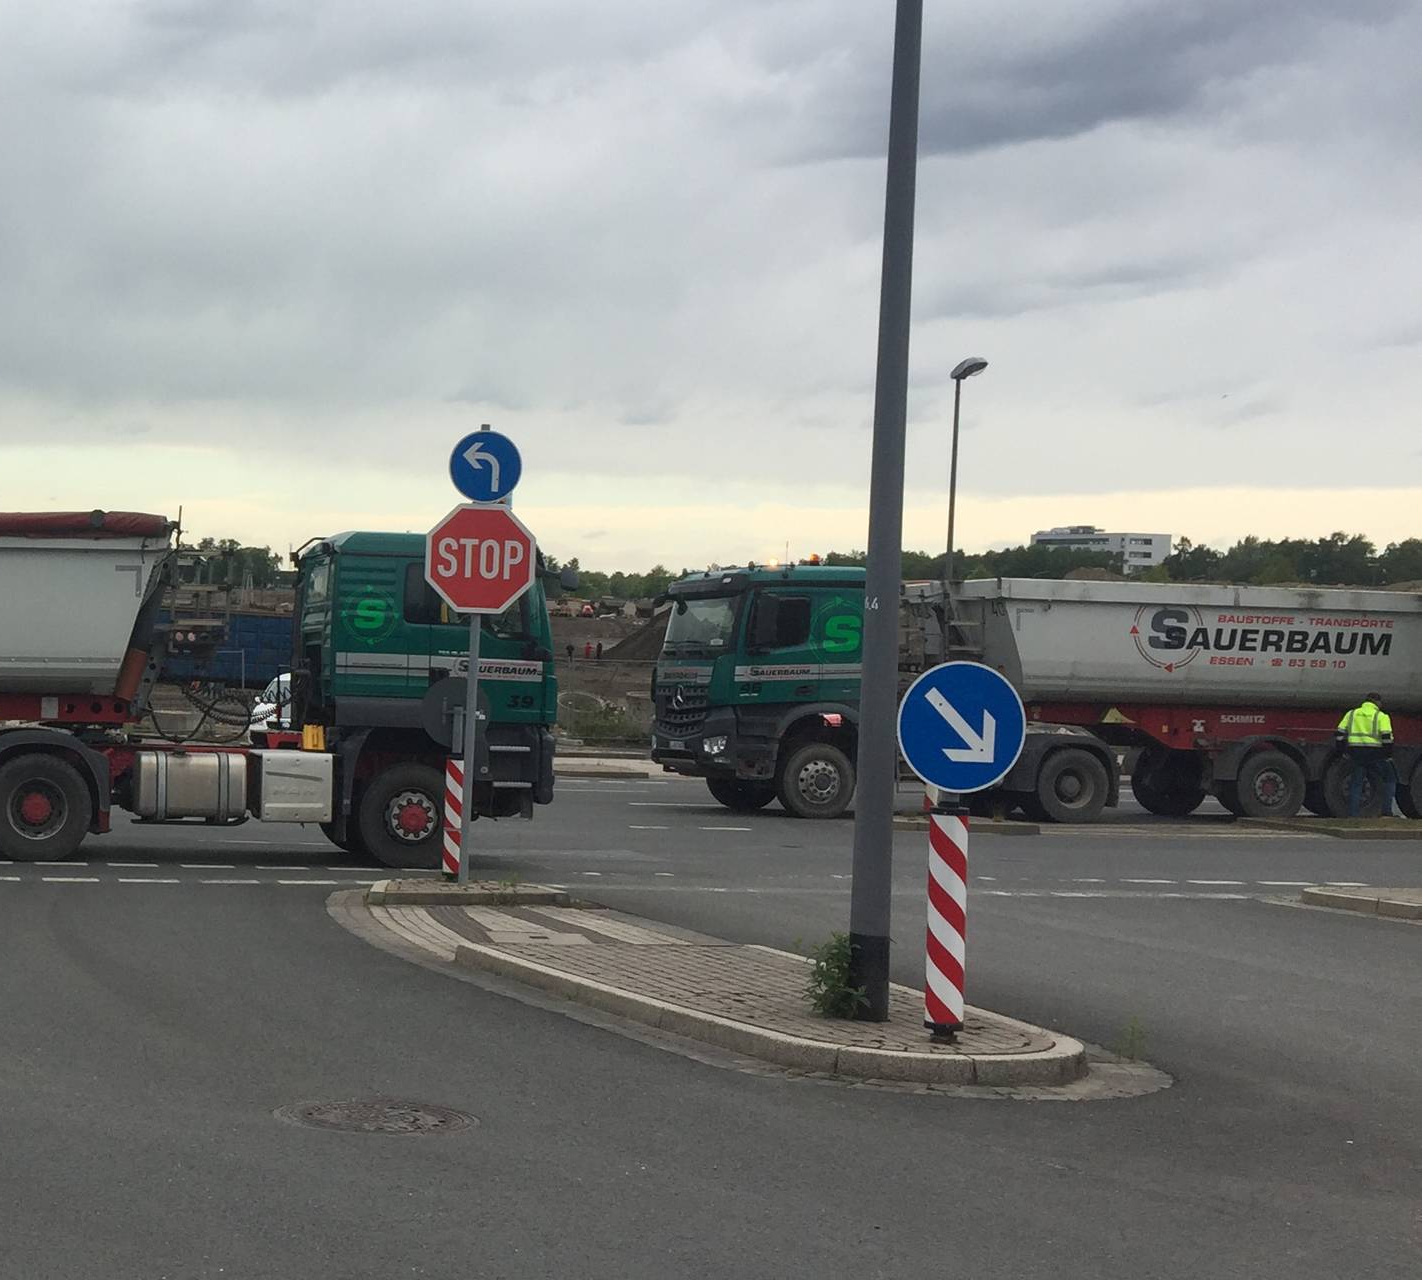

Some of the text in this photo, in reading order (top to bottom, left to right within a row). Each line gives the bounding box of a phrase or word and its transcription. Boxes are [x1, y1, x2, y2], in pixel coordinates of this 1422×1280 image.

[437, 537, 524, 581] STOP
[353, 599, 388, 630] S
[1217, 614, 1295, 626] BAUSTOFFE
[1308, 617, 1395, 630] TRANSPORTE
[822, 615, 863, 653] S
[1148, 608, 1393, 656] SAUERBAUM
[457, 660, 536, 676] SUERBAUM
[1209, 656, 1347, 669] ESSEN 83 59 10
[749, 666, 811, 677] SAUERBAUM
[507, 694, 534, 709] 39
[1220, 713, 1266, 724] SCHMITZ
